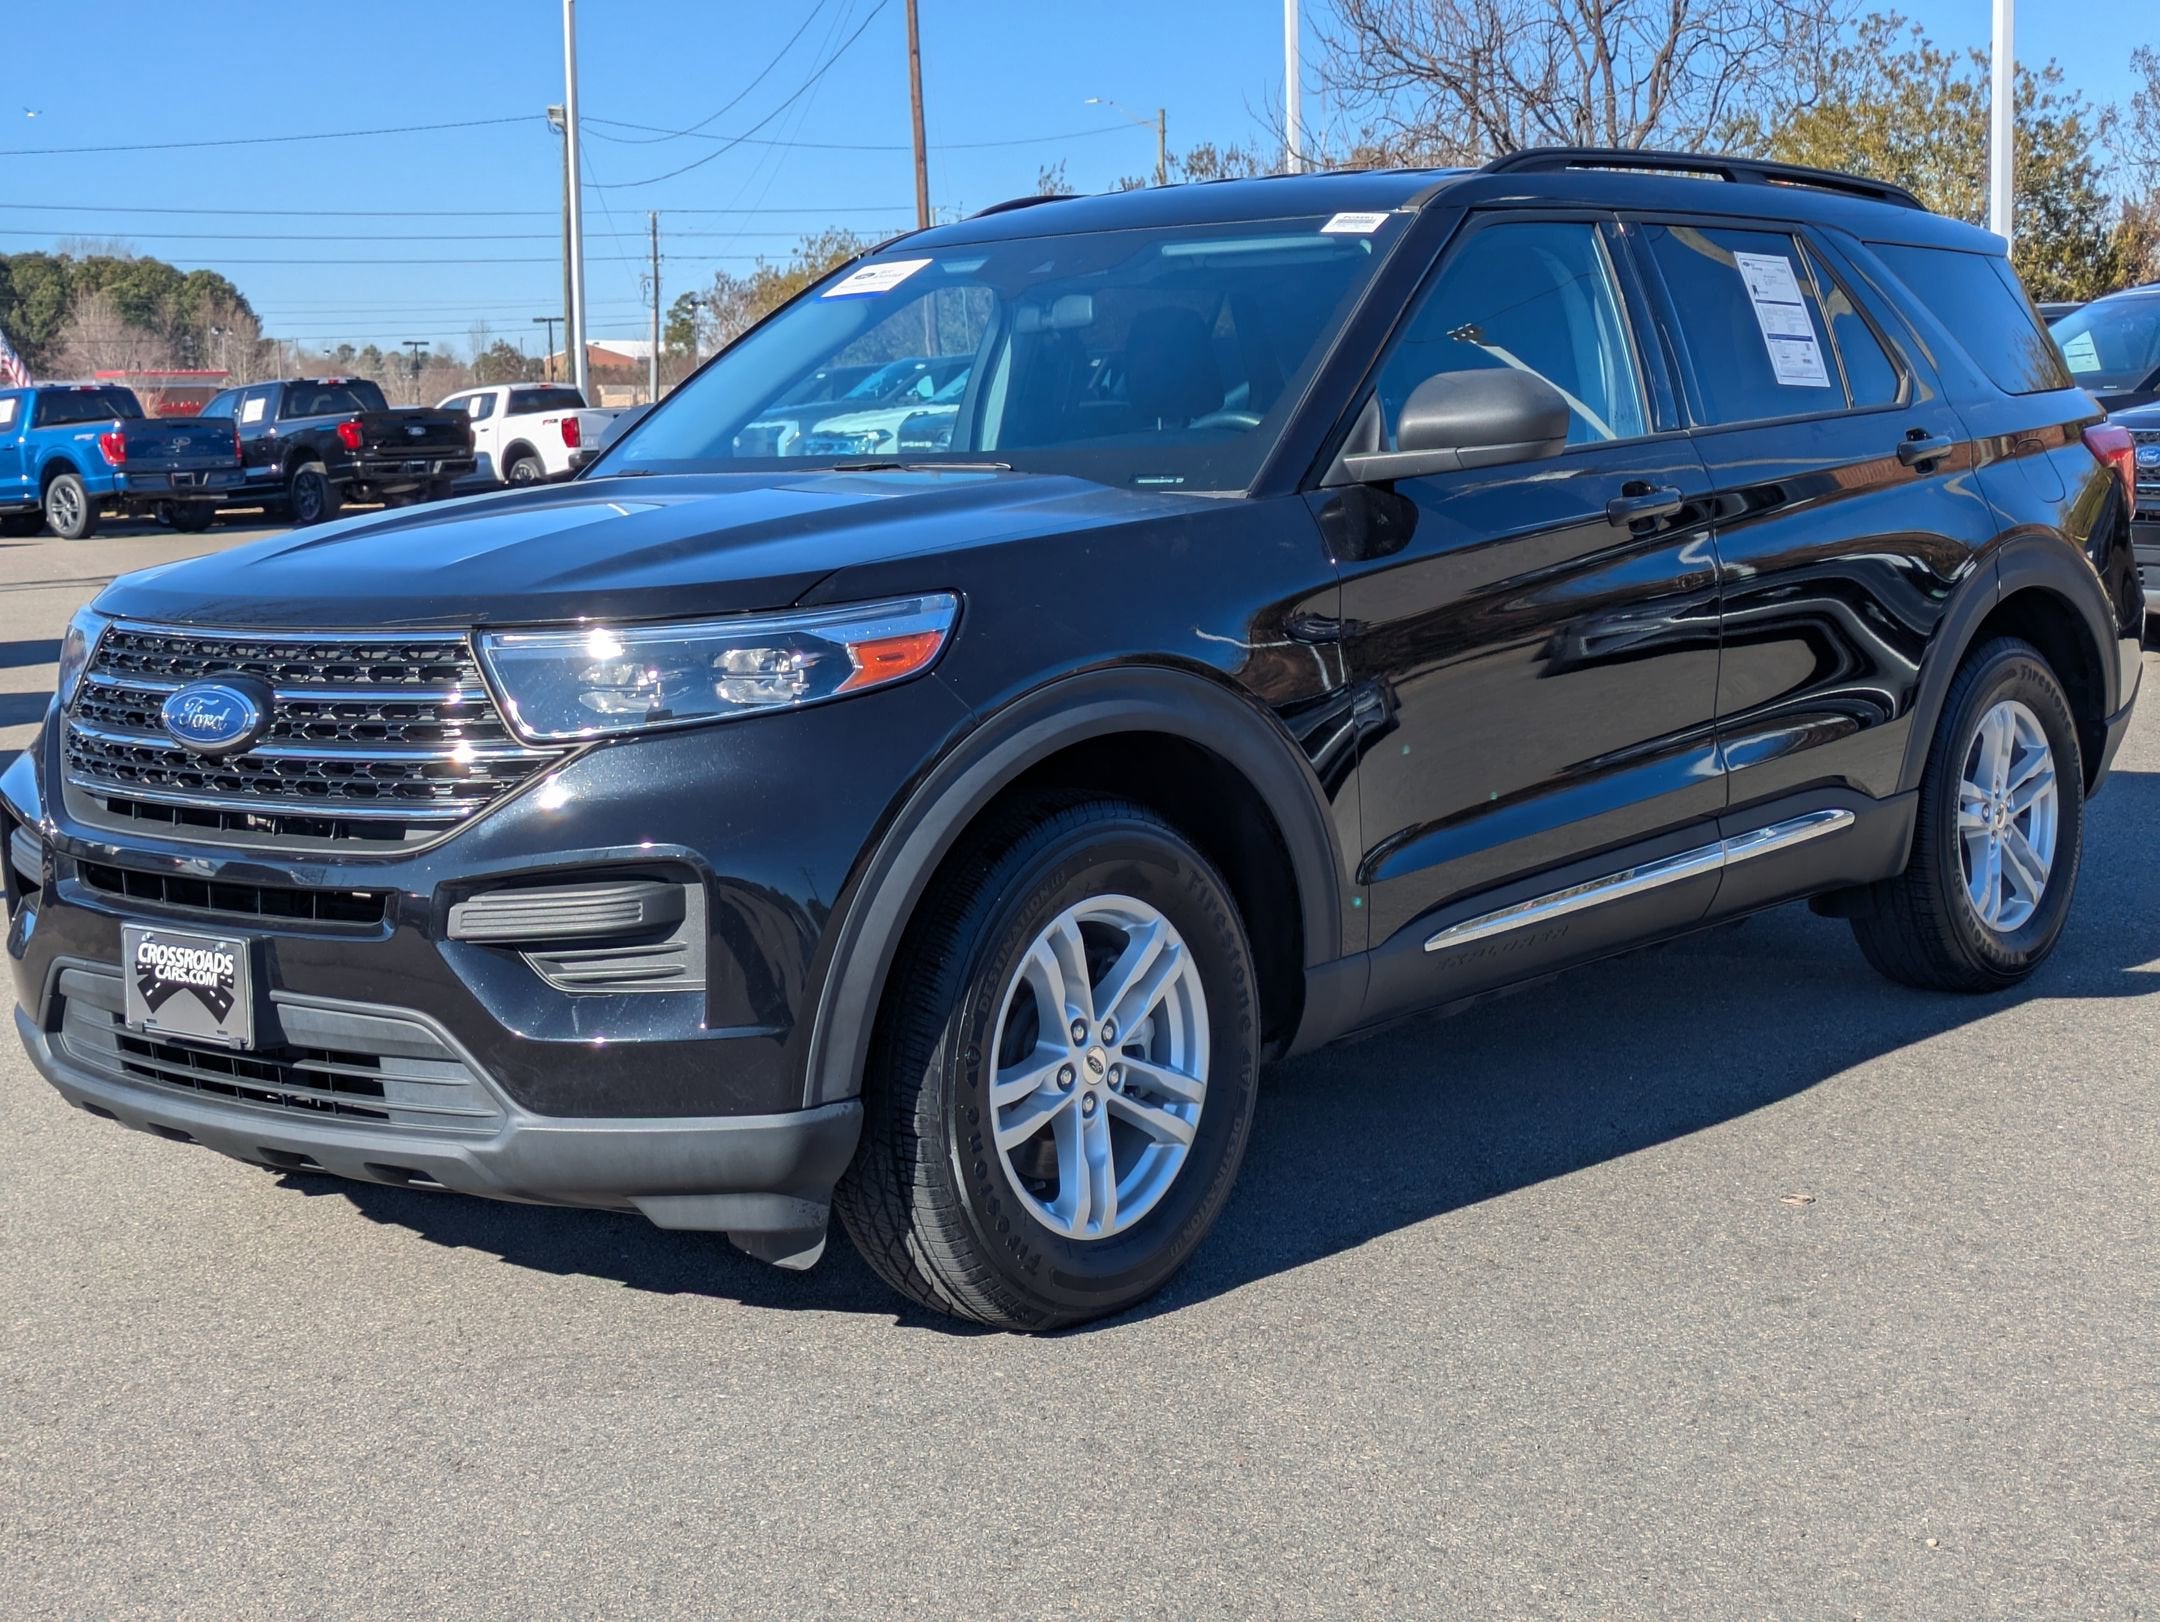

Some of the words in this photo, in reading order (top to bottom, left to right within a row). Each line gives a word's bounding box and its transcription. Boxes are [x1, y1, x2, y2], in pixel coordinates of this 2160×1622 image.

[179, 696, 231, 732] Ford
[137, 942, 234, 976] CROSSROADS
[978, 883, 1050, 1012] DESTINATION
[1185, 871, 1252, 1034] Firestone
[154, 964, 218, 988] CARS.COM
